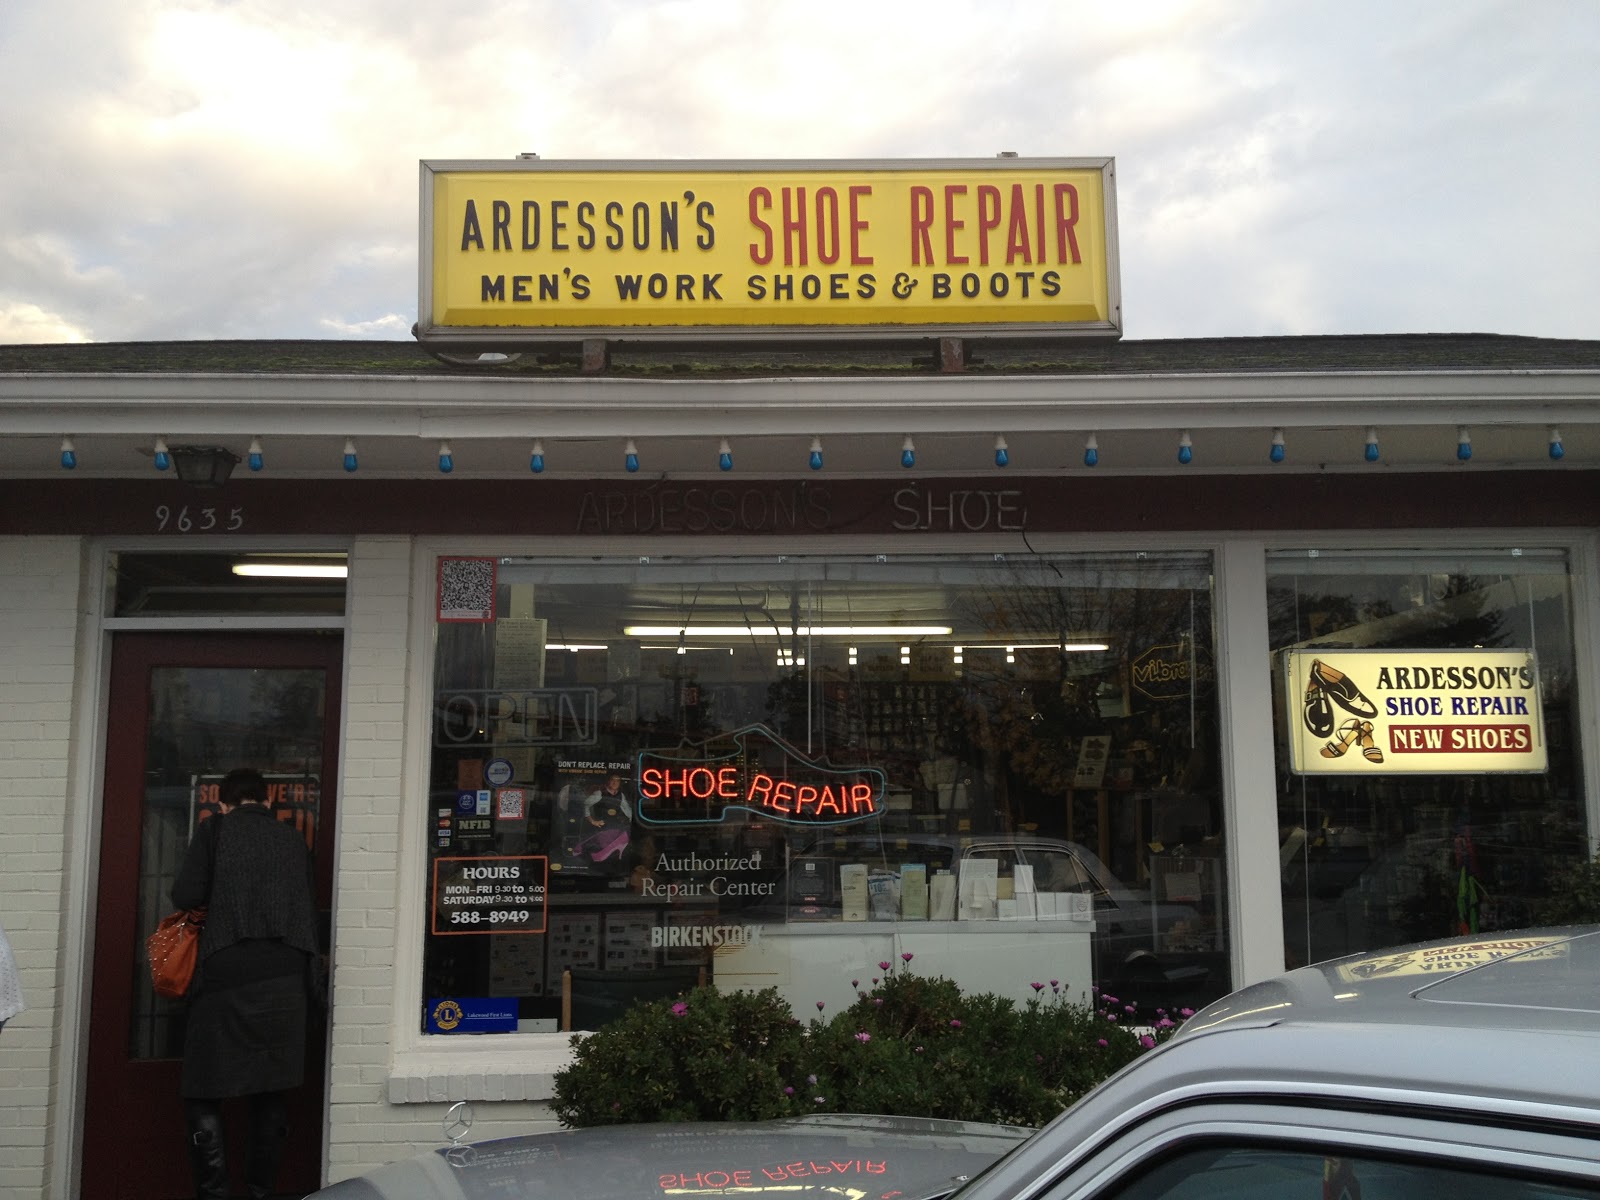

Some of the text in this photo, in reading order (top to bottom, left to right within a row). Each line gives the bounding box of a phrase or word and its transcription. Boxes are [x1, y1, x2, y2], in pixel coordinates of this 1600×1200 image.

[461, 183, 1082, 267] ARDESSON'S SHOE REPAIR
[481, 267, 1061, 302] MEN'S WORK SHOES & BOOTS
[156, 505, 243, 532] 9635
[892, 489, 1023, 531] SHOE
[1376, 666, 1535, 690] ARDESSON'S
[1386, 696, 1529, 716] SHOE REPAIR
[444, 693, 590, 742] OPEN
[1393, 728, 1528, 749] NEW SHOES
[558, 760, 577, 768] DON'T
[642, 768, 874, 815] SHOE REPAIR
[458, 820, 491, 830] NFIB
[654, 851, 763, 872] Authorized
[463, 867, 520, 879] HOURS
[512, 885, 524, 893] to
[641, 877, 776, 902] Repair Center
[443, 896, 495, 905] SATURDAY
[515, 895, 527, 903] to
[451, 910, 529, 923] 588-8949
[651, 924, 763, 947] BIRKENSTOCK
[444, 1009, 452, 1020] L
